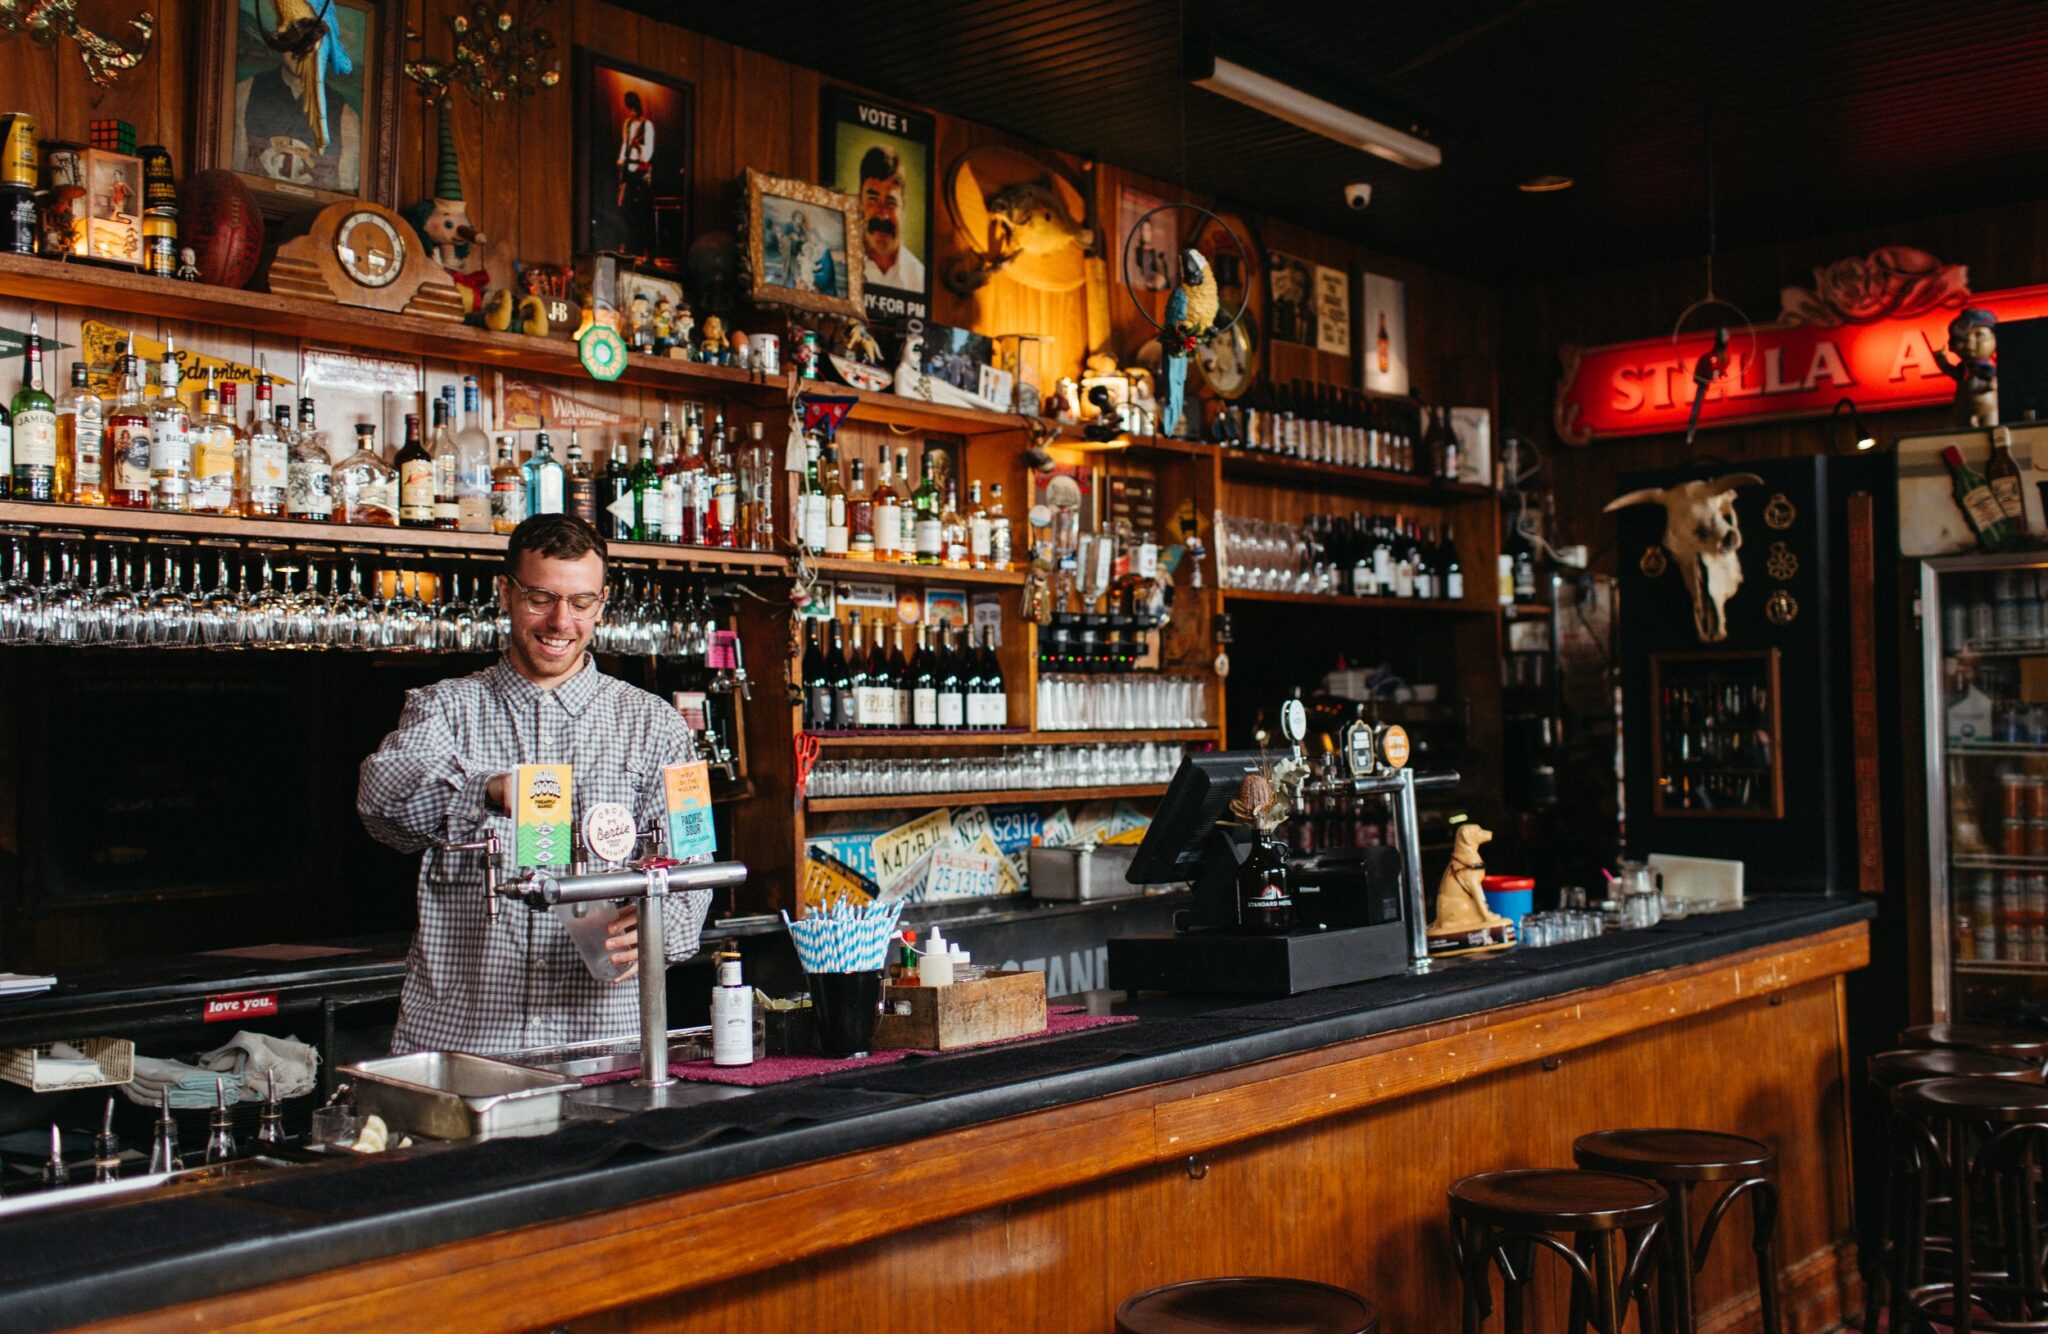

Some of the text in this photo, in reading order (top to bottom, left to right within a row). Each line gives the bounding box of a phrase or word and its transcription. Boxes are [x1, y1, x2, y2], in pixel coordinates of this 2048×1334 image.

[858, 104, 908, 133] VOTE 1
[879, 296, 905, 315] FOR
[906, 301, 925, 318] PM
[176, 350, 257, 382] Edmonton
[306, 350, 359, 365] STANDARD
[380, 360, 414, 373] WORKS
[551, 394, 620, 424] WAINWRIGHT
[681, 812, 703, 826] PACIFIC
[685, 823, 701, 836] SOUR
[597, 824, 630, 841] Bertie
[1001, 946, 1109, 999] AND
[209, 997, 273, 1013] love you.
